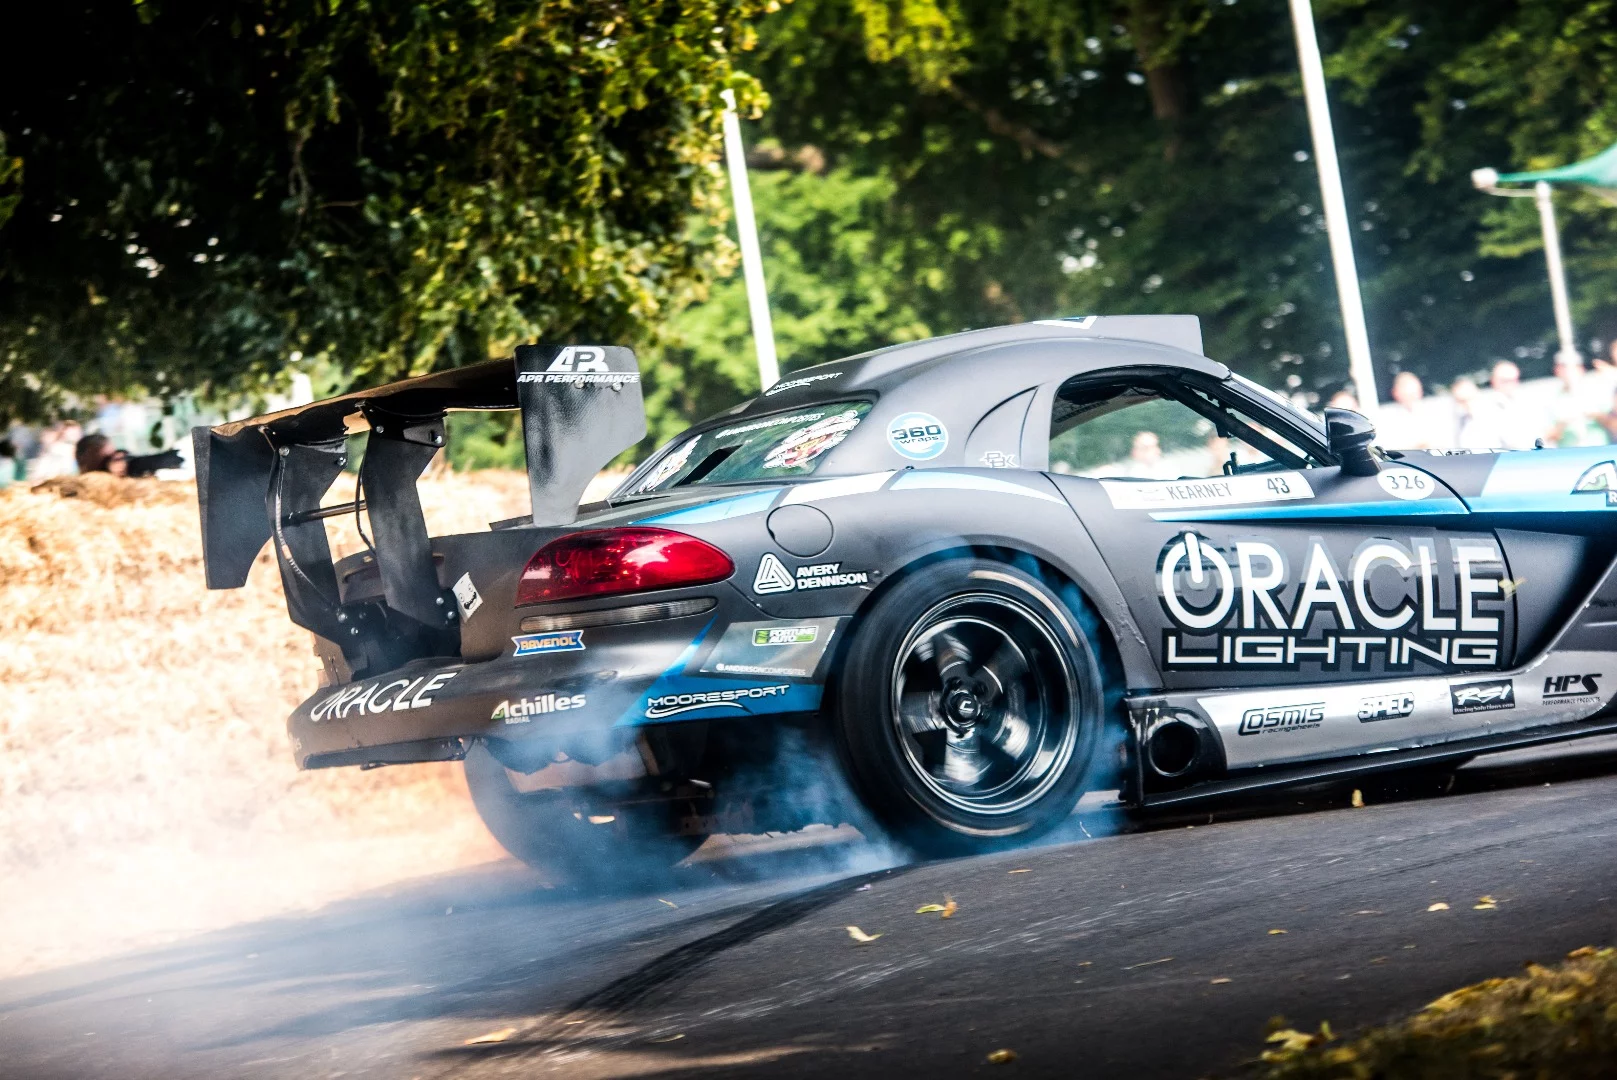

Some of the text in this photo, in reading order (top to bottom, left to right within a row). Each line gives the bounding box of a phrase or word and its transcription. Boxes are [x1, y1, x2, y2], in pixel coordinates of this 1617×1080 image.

[517, 374, 640, 383] APR PERFORMANCE
[892, 425, 942, 440] 360
[900, 436, 939, 444] wraps
[1166, 482, 1232, 500] KEARNEY
[1267, 477, 1290, 494] 43
[1386, 475, 1425, 490] 326
[796, 563, 840, 578] AVERY
[797, 573, 868, 590] DENNISON
[1161, 532, 1499, 632] ORACLE
[520, 637, 577, 650] RAVENOL
[1167, 636, 1498, 665] LIGHTING
[648, 684, 790, 707] MOORESPORT
[1543, 673, 1603, 698] HPS
[310, 672, 458, 722] ORACLE
[491, 694, 587, 719] Achilles
[1358, 696, 1414, 719] SPEC
[505, 715, 531, 725] RADIAL
